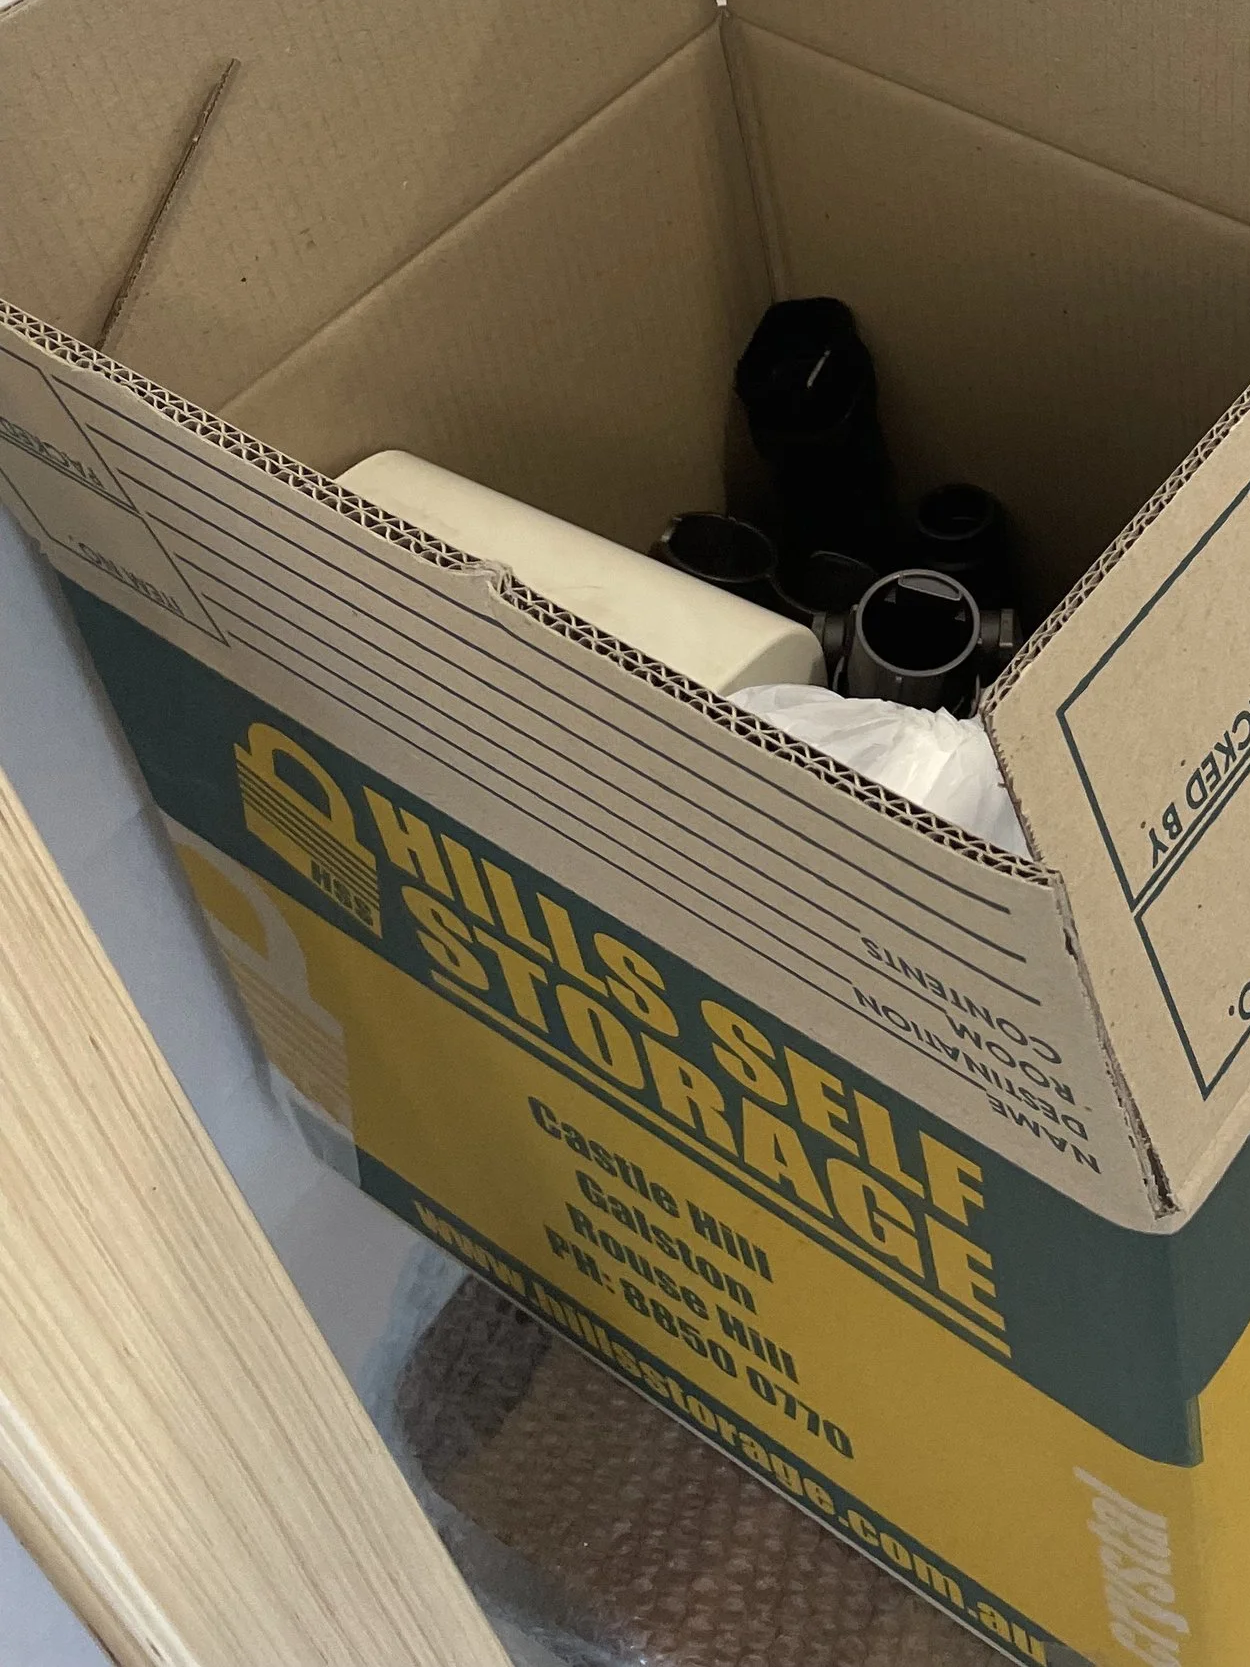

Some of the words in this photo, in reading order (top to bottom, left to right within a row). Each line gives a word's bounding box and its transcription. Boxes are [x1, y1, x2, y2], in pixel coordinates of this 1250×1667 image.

[311, 859, 374, 928] HSS
[1148, 801, 1183, 869] BY
[363, 785, 679, 1037] HILLS
[701, 1000, 985, 1227] SELF
[852, 986, 1089, 1141] DESTINATION
[860, 936, 1063, 1065] CONTENTS
[945, 1012, 1076, 1106] ROOM
[401, 885, 1006, 1332] STORAGE
[986, 1093, 1102, 1175] NAME
[528, 1096, 680, 1218] Castle
[686, 1199, 774, 1283] Hill
[575, 1169, 757, 1315] Galston
[543, 1224, 615, 1294] PH:
[619, 1277, 739, 1378] 8850
[746, 1365, 854, 1459] 0770
[565, 1201, 710, 1321] Rouse
[715, 1304, 800, 1385] Hill
